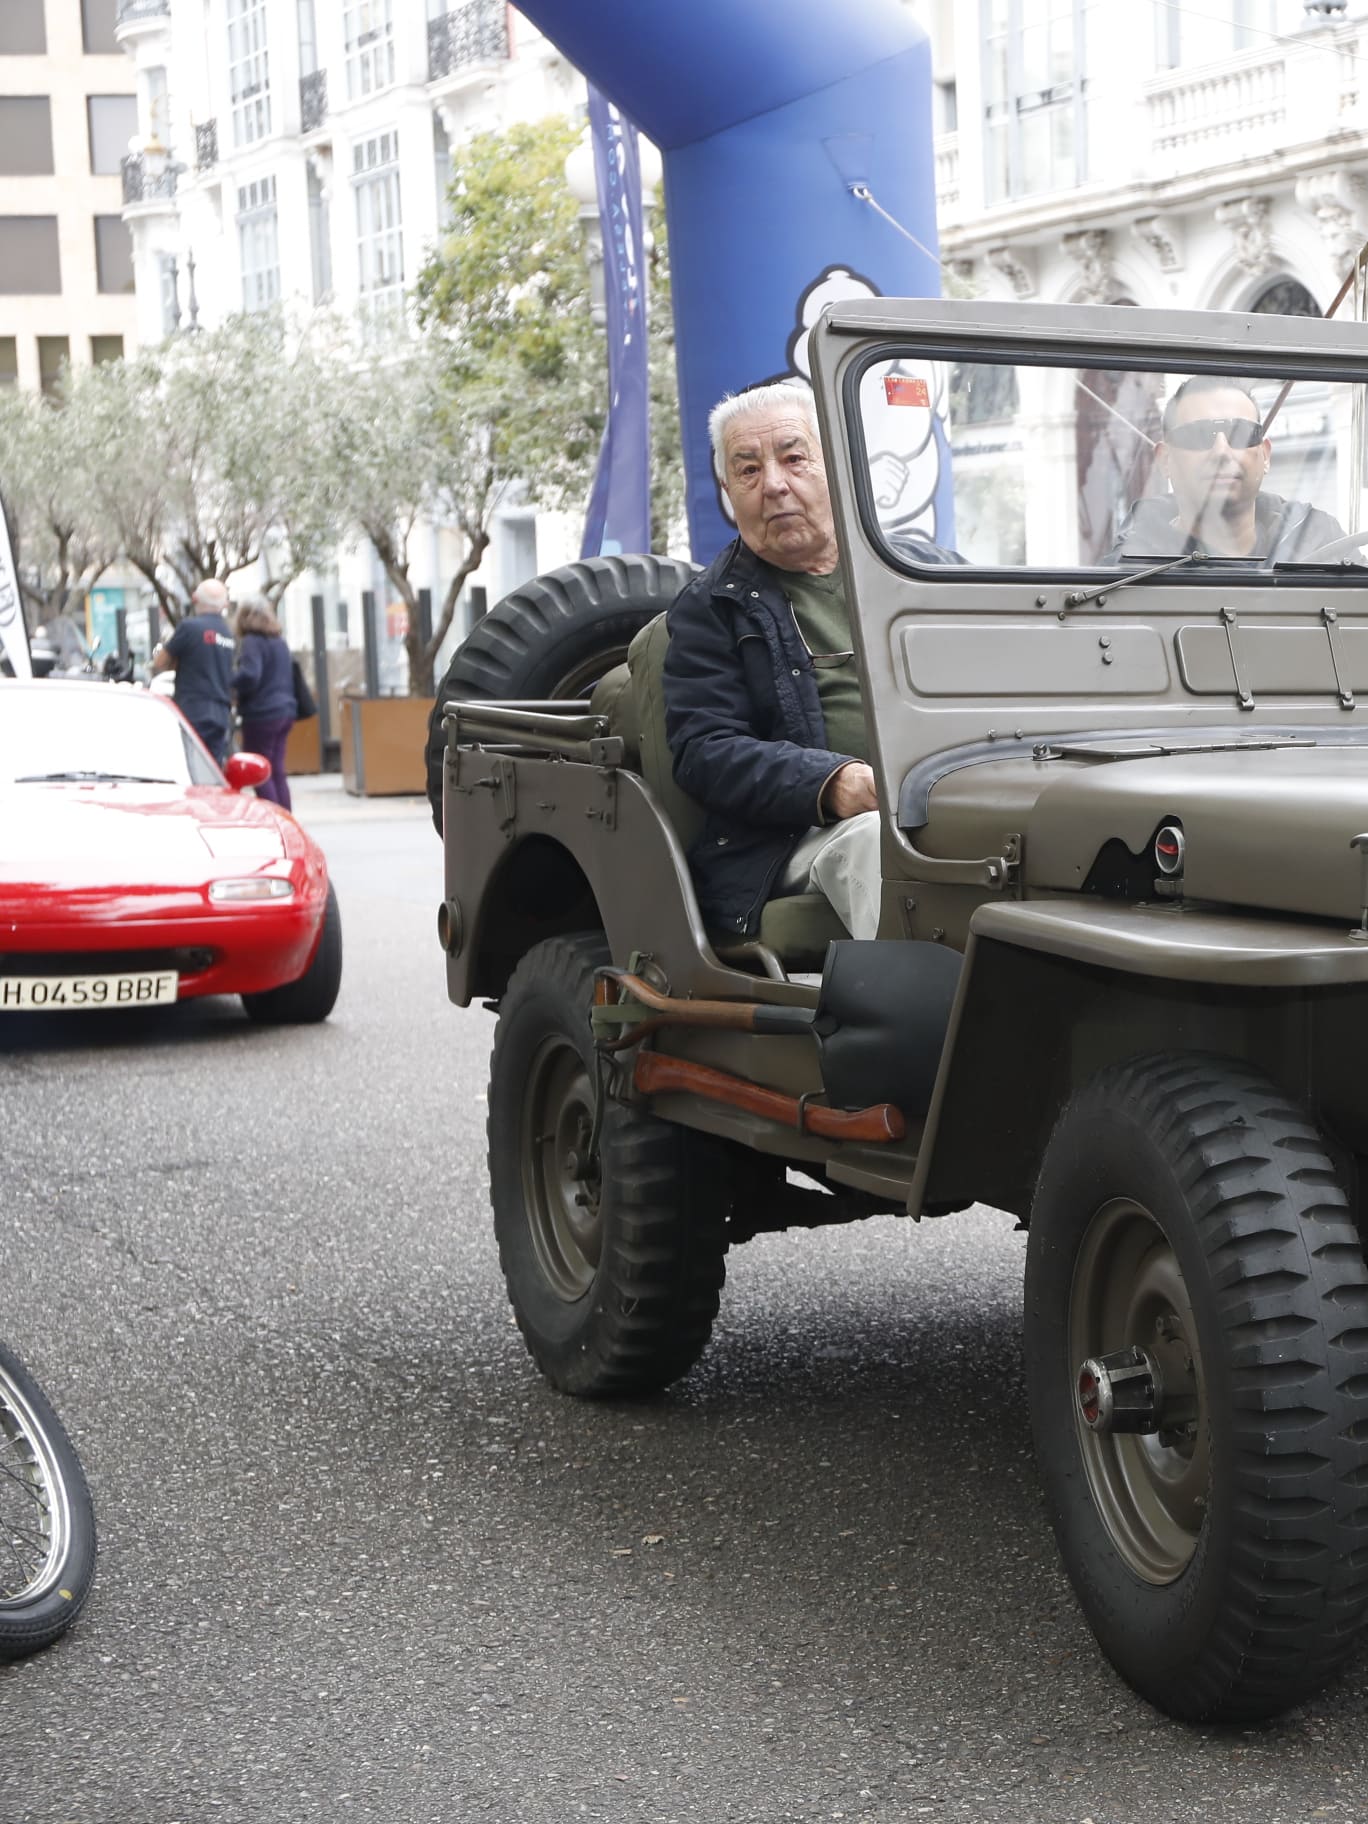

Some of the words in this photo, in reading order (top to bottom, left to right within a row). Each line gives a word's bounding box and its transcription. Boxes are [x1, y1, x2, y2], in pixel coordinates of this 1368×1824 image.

[3, 980, 22, 1005] H
[30, 979, 109, 1005] 0459
[117, 975, 172, 1002] BBF
